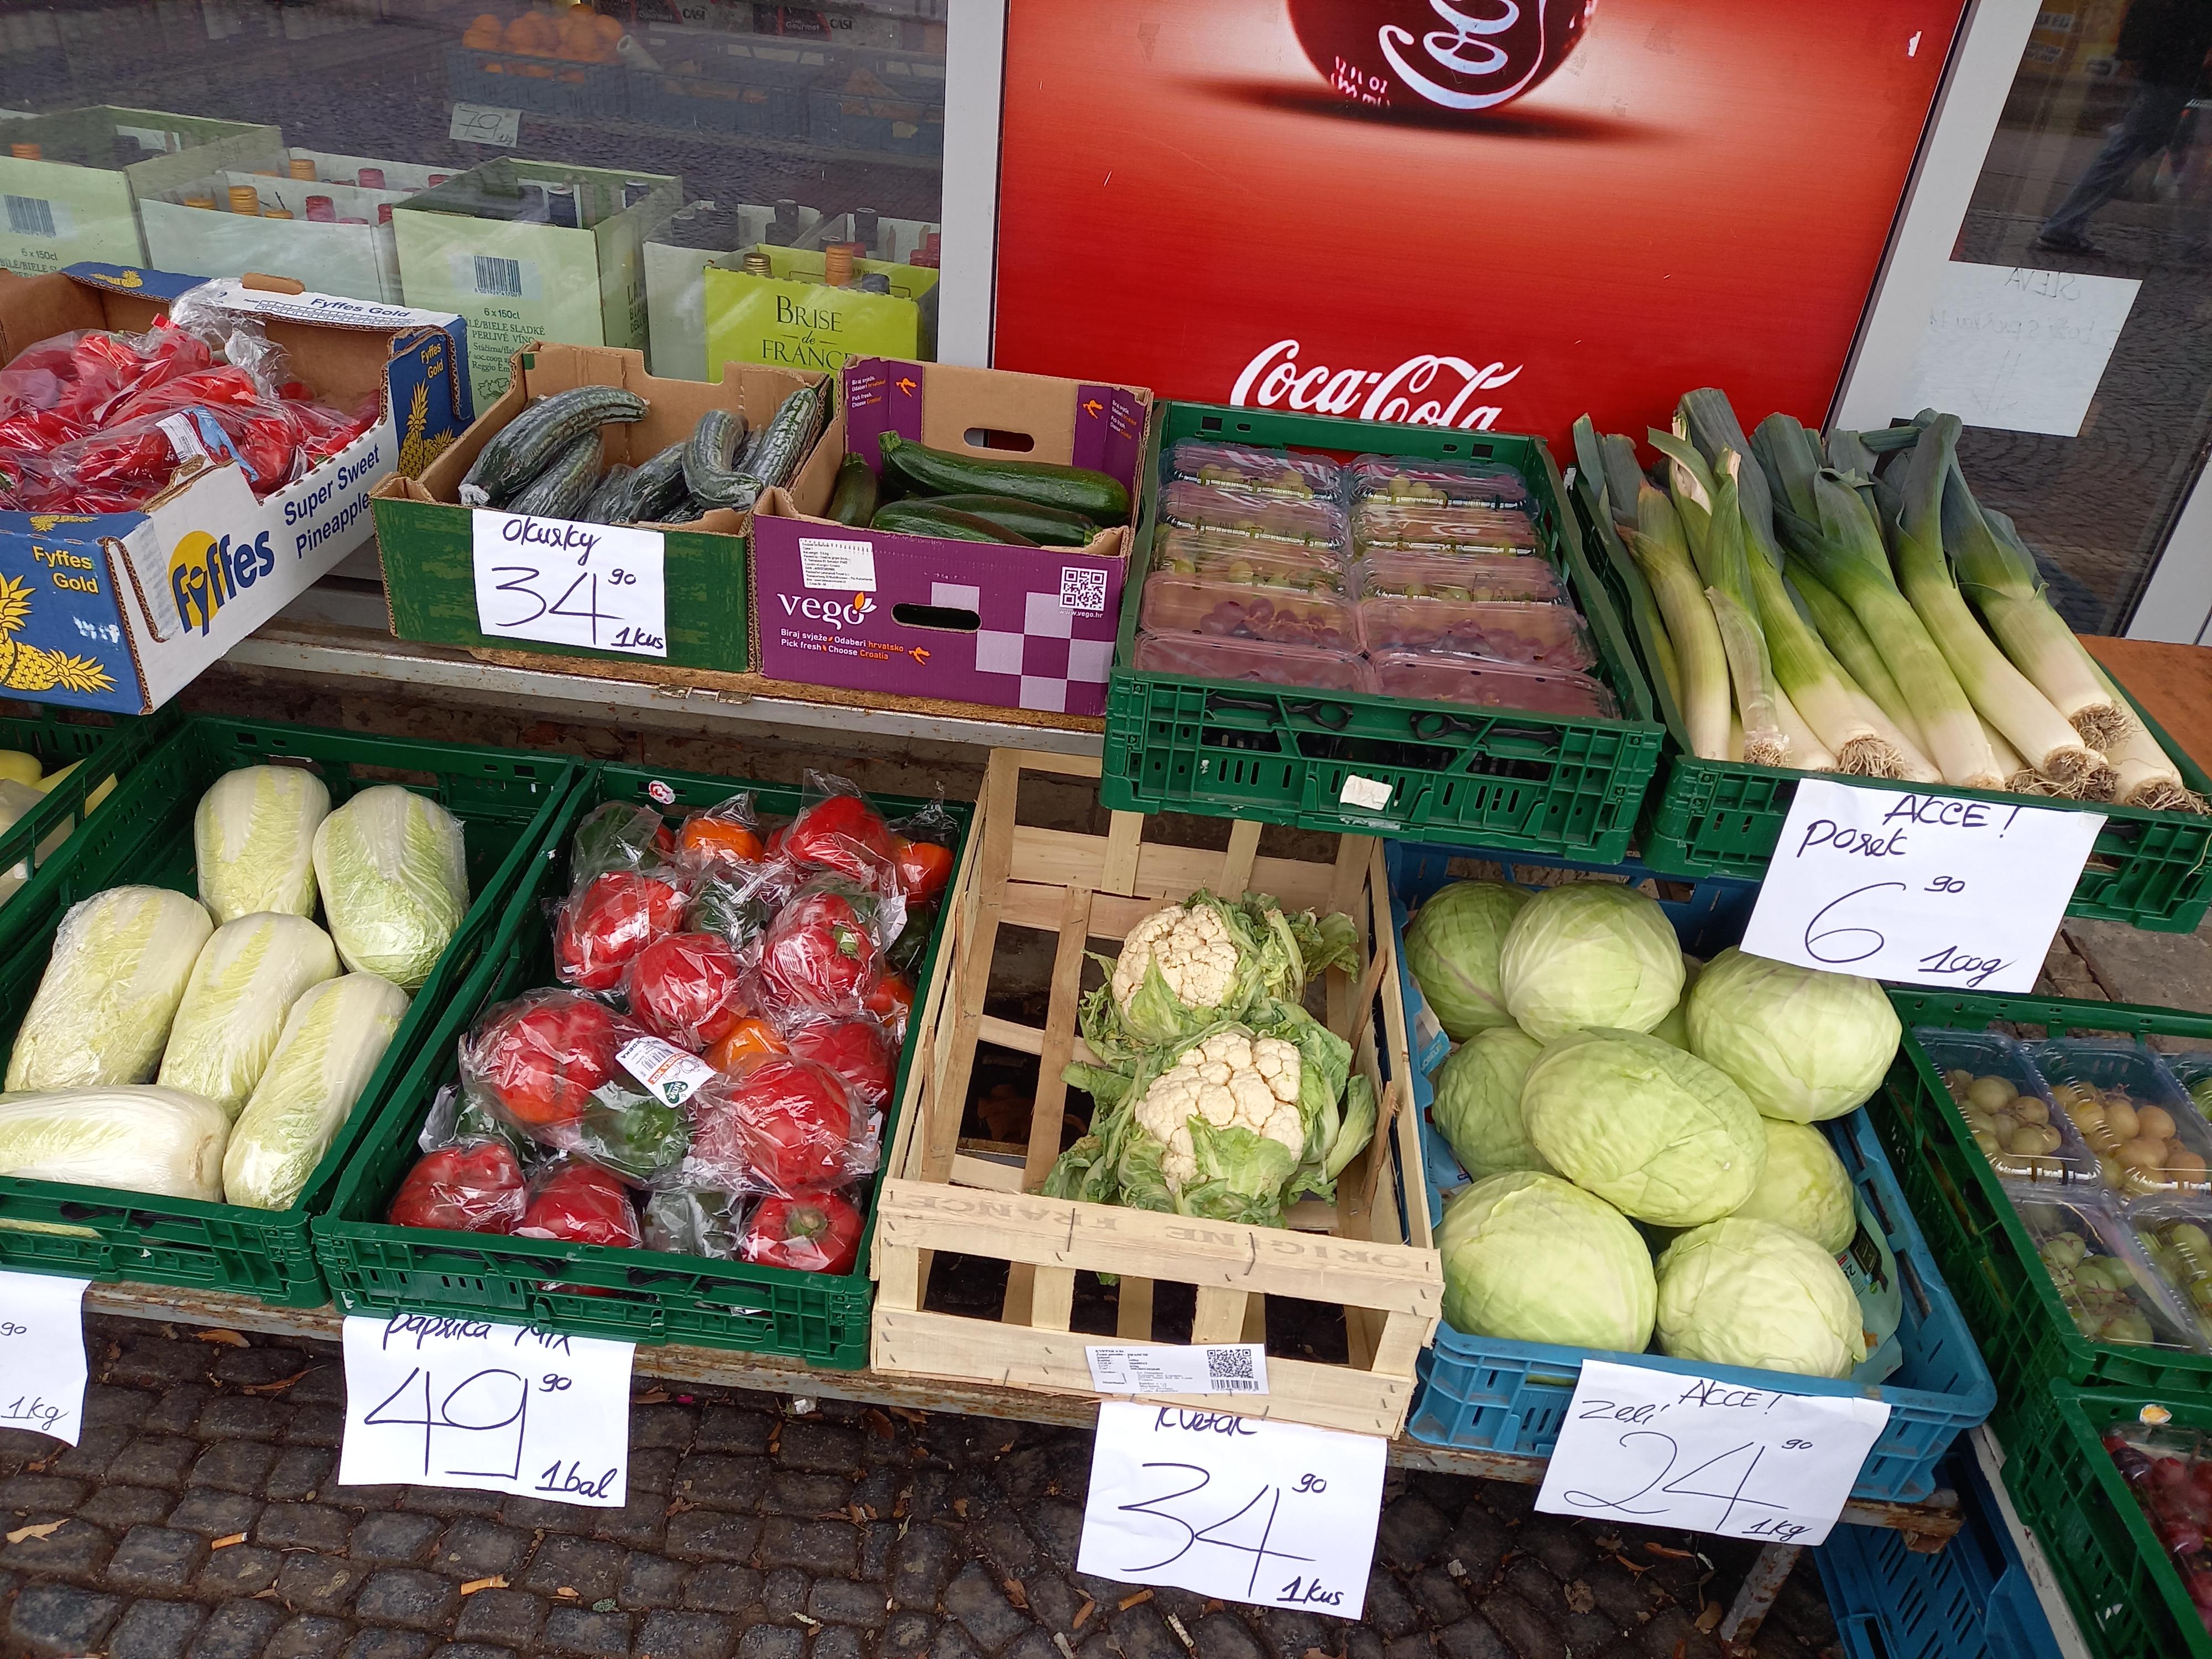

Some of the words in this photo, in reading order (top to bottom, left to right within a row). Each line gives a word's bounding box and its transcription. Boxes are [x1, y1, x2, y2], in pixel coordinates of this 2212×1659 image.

[311, 299, 363, 311] Fyffes
[369, 307, 410, 317] Gold
[466, 319, 508, 332] LÉ/BIELE
[802, 331, 816, 345] de
[420, 342, 441, 364] Fyffes
[427, 358, 445, 379] Gold
[1230, 340, 1524, 431] Coca-Cola
[285, 479, 333, 525] Super
[337, 446, 380, 491] Sweet
[296, 492, 370, 559] Pineapple
[33, 545, 93, 570] Fyffes
[53, 572, 100, 594] Gold
[171, 529, 275, 638] Fyffes
[491, 566, 626, 645] 34
[1058, 609, 1104, 619] www.vego.hr
[781, 628, 800, 639] Biraj
[802, 632, 827, 641] svježe
[834, 637, 867, 647] Odaberi
[868, 640, 904, 652] hrvatsko
[781, 639, 799, 648] Pick
[800, 641, 821, 651] fresh
[828, 645, 858, 656] Choose
[860, 650, 889, 660] Croatia
[1804, 881, 1907, 964] 6
[364, 1367, 529, 1481] 49
[1563, 1431, 1790, 1531] 24
[1118, 1462, 1317, 1598] 34
